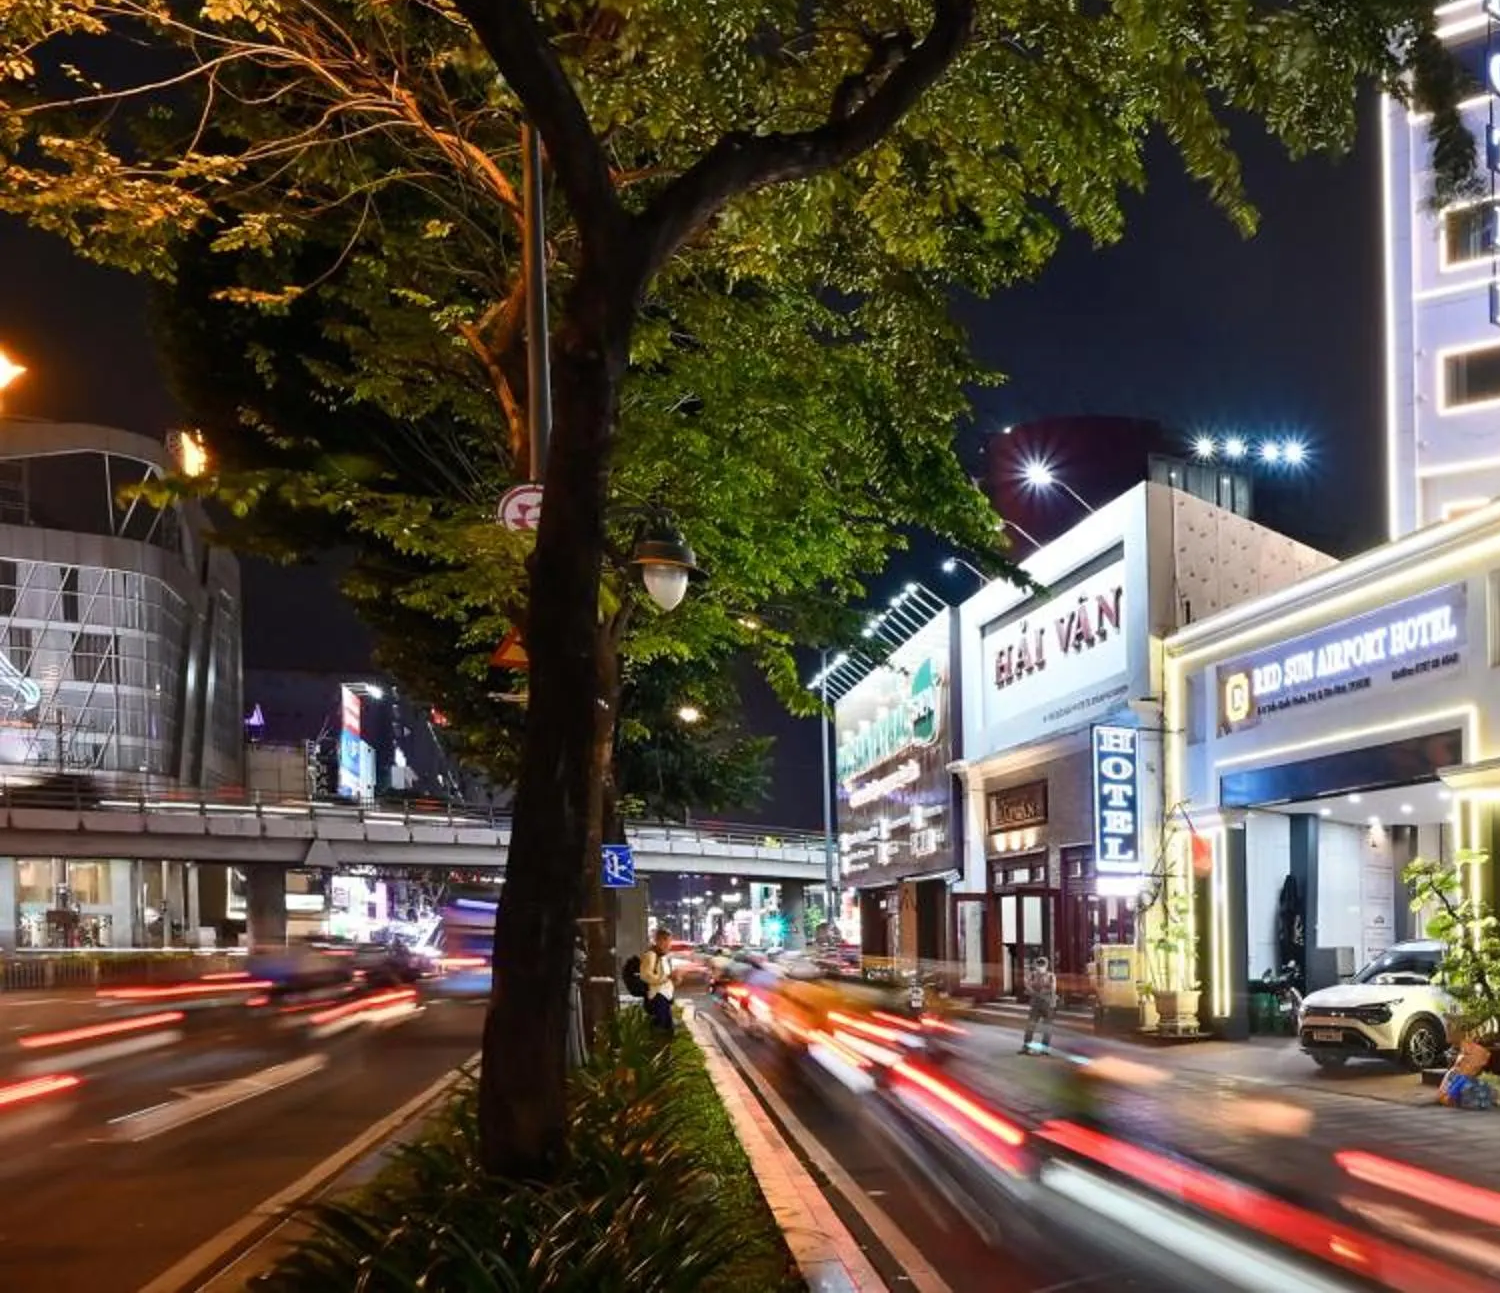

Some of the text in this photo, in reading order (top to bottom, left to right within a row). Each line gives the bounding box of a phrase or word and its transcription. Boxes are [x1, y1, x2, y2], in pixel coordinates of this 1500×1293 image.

[994, 620, 1046, 691] HẢI
[1252, 662, 1283, 697] RED
[1283, 650, 1317, 688] SUN
[1315, 627, 1389, 678] AIRPORT
[1389, 605, 1458, 657] HOTEL
[1099, 729, 1135, 861] HOTEL
